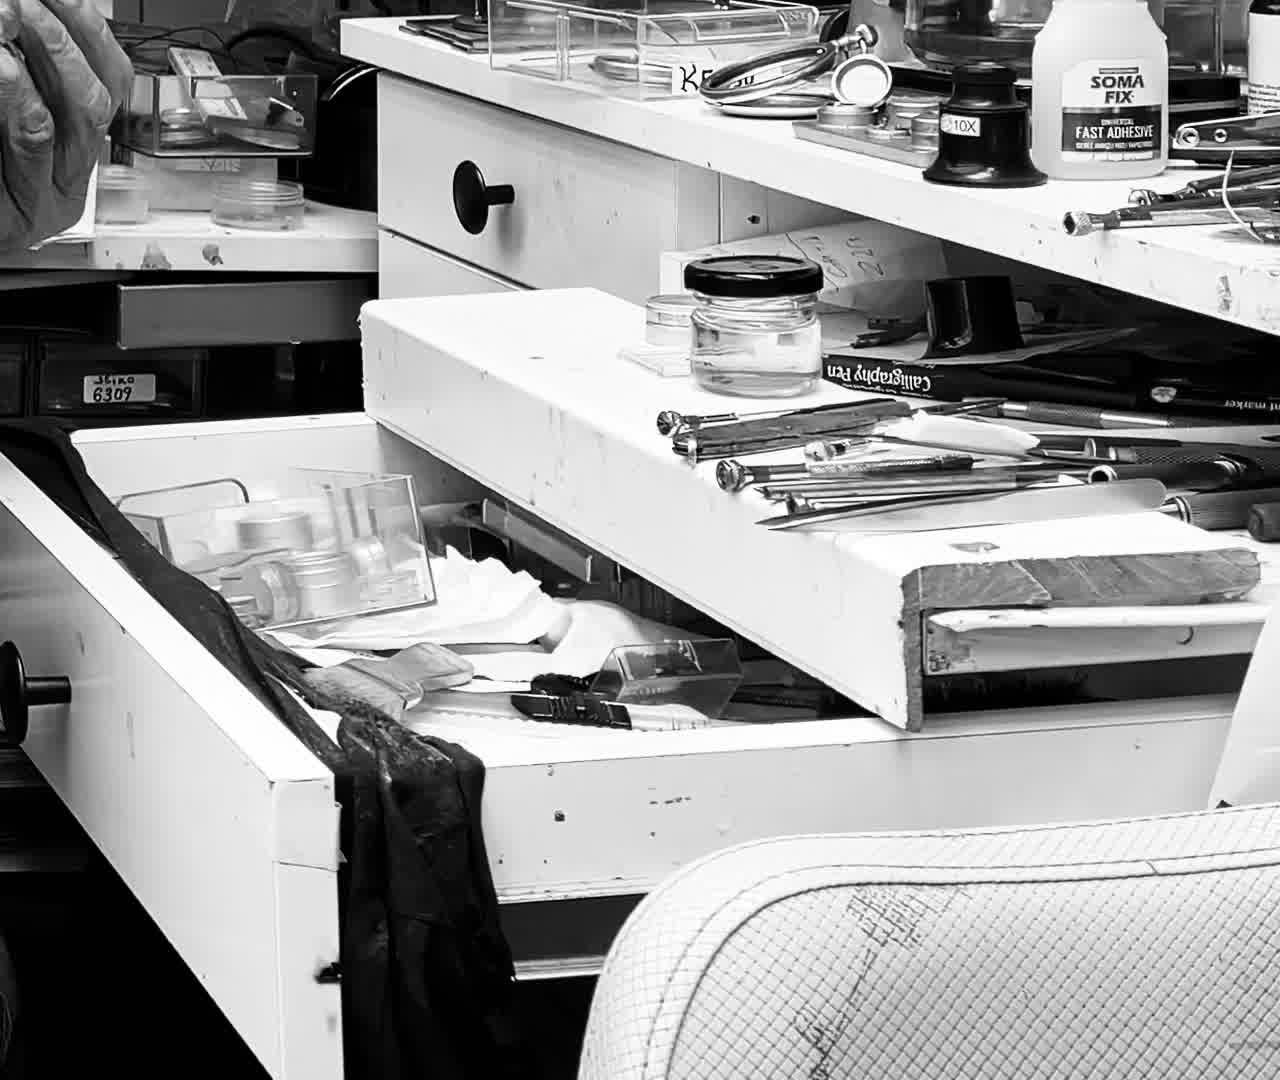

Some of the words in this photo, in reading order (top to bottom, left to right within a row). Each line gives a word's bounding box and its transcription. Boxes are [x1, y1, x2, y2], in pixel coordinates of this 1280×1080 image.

[1090, 74, 1144, 89] SOMA
[1104, 90, 1133, 105] FIX
[952, 118, 977, 135] 10X
[1075, 125, 1104, 139] FAST
[1106, 124, 1153, 139] ADHESIVE
[826, 363, 852, 384] Pen
[853, 366, 932, 394] Calligraphy
[92, 386, 133, 402] 6309
